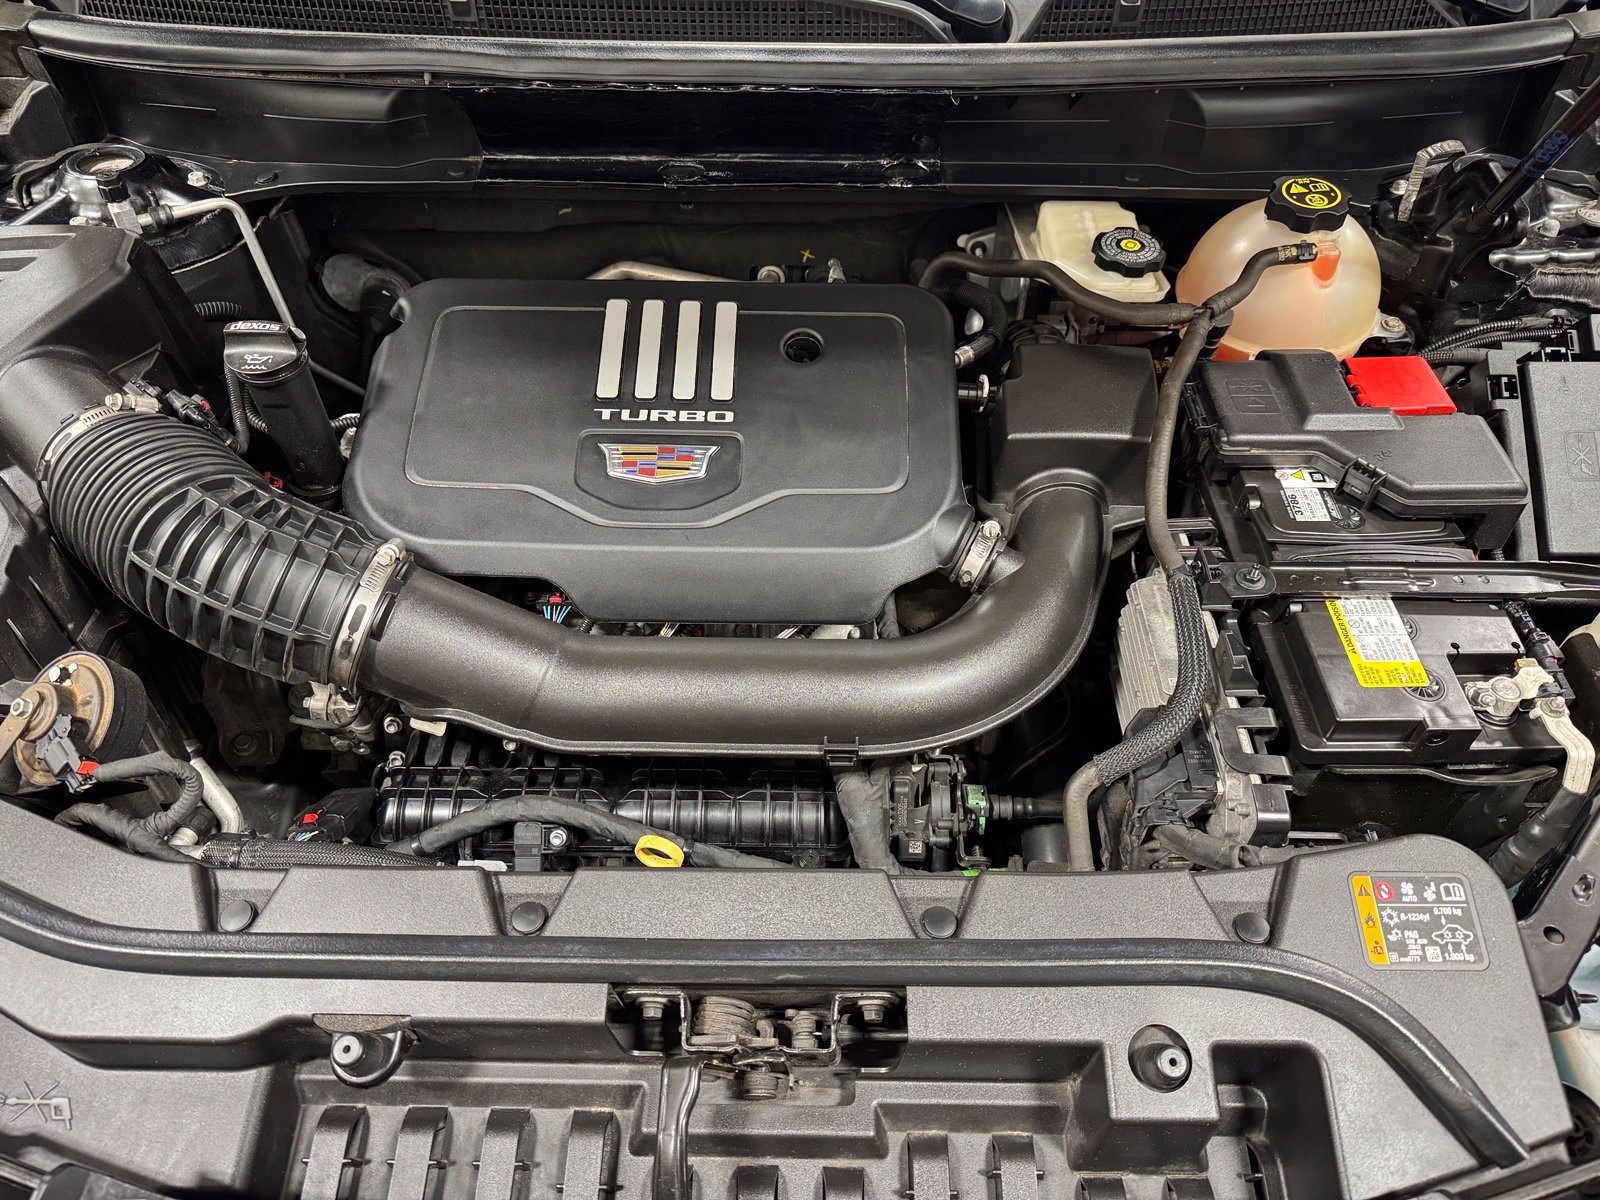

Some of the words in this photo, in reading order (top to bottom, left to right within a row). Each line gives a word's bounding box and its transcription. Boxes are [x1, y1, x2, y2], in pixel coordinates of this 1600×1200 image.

[230, 321, 281, 331] dexos
[593, 408, 735, 423] TURBO
[1288, 494, 1303, 516] 3786
[1329, 600, 1344, 621] POISO
[1338, 622, 1354, 648] DANGER
[1400, 912, 1430, 922] R-1234yf
[1452, 907, 1462, 917] kg
[1404, 930, 1419, 938] PAG
[1444, 952, 1464, 960] 1.000
[1464, 952, 1475, 962] kg
